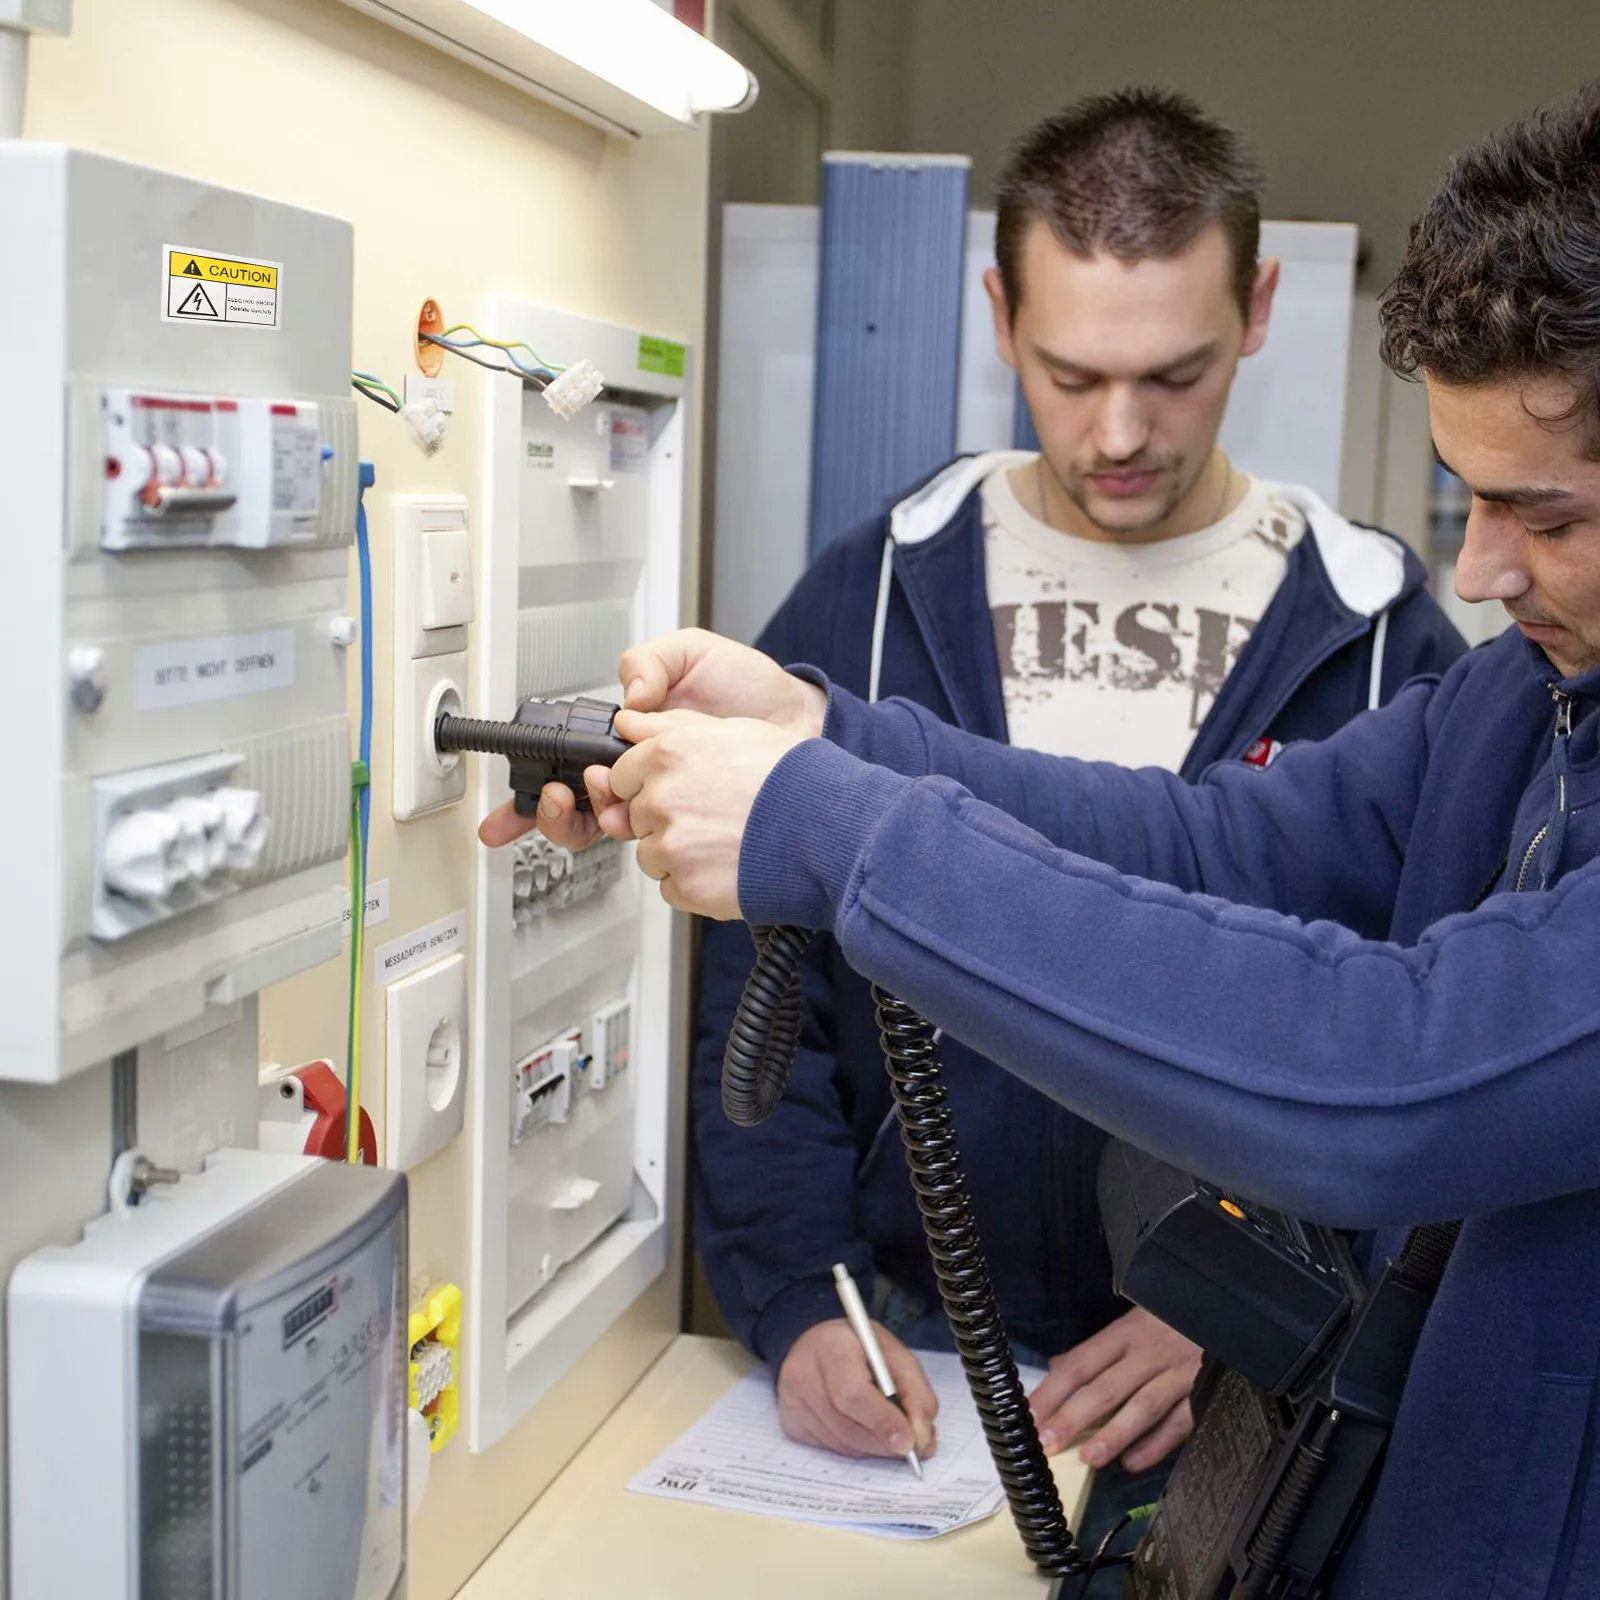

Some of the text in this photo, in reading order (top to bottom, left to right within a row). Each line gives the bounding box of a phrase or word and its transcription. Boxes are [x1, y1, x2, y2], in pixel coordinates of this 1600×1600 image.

[209, 265, 271, 283] CAUTION
[385, 927, 458, 968] MESSADAPTER BENUTZEN
